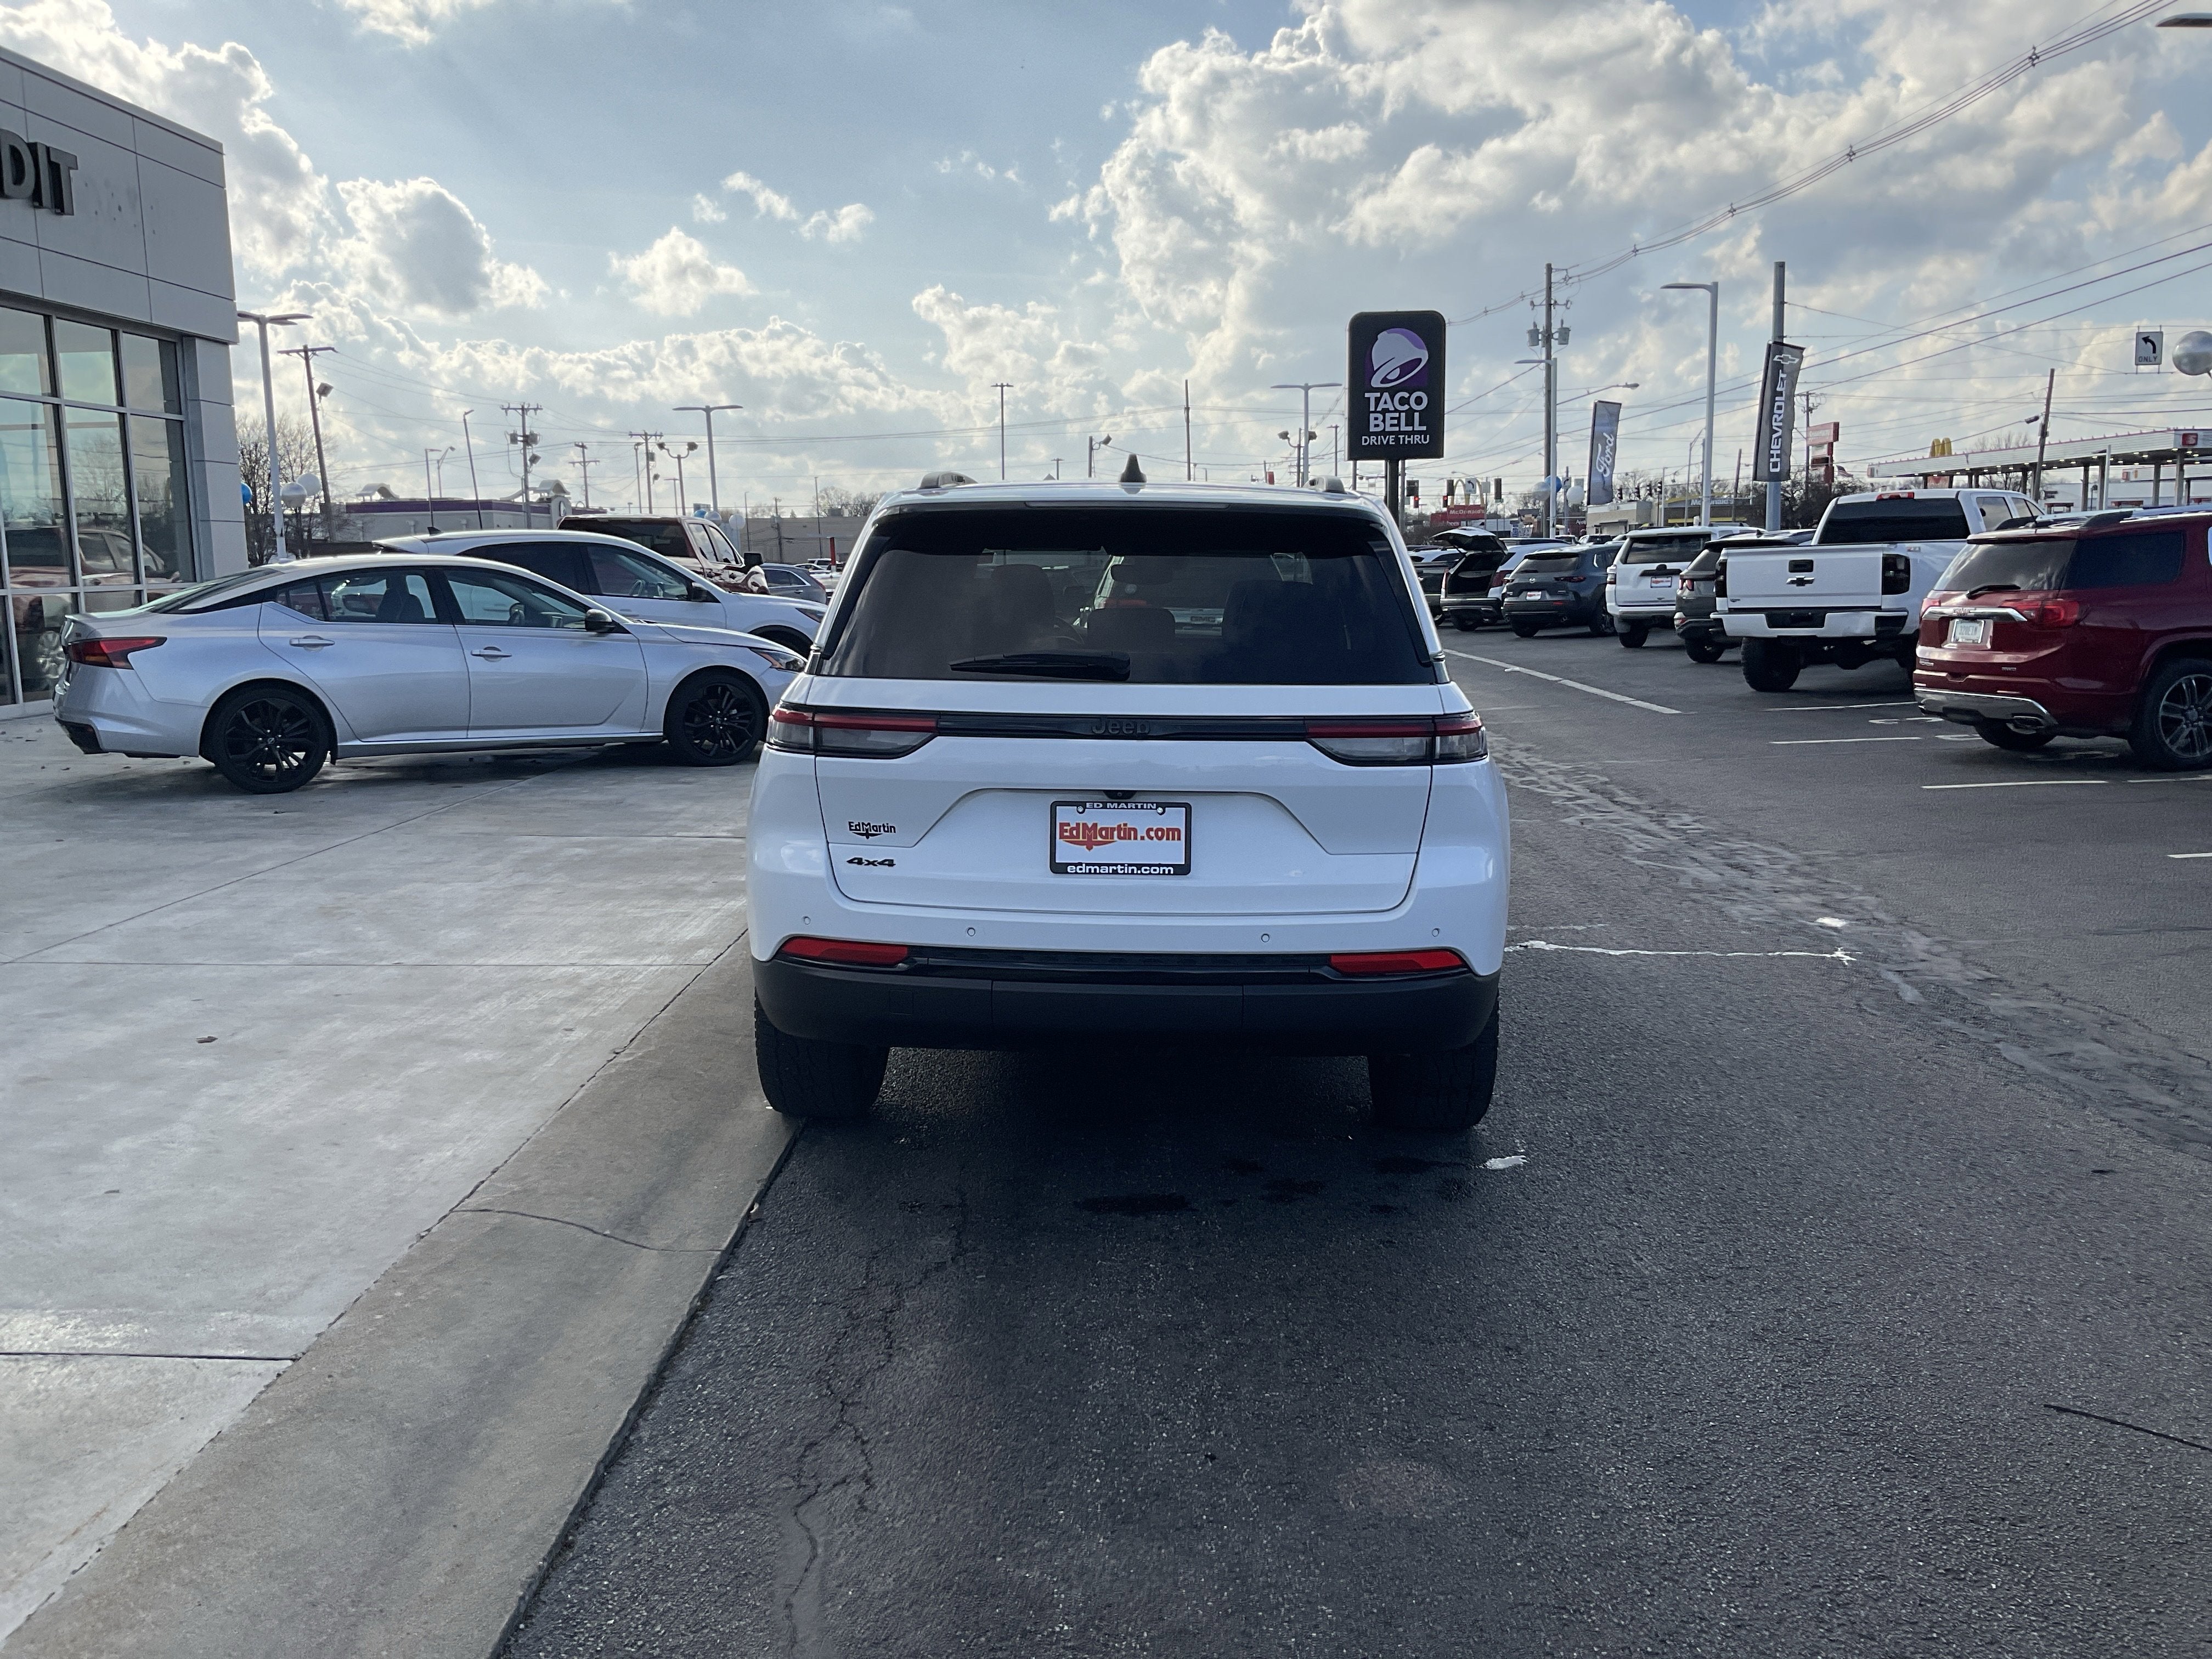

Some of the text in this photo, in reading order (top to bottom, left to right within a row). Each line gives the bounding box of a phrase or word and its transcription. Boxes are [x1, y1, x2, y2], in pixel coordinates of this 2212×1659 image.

[1364, 391, 1428, 411] TACO
[1369, 412, 1426, 432] BELL
[1769, 369, 1787, 473] CHEVROLET
[1362, 435, 1430, 445] DRIVE THRU
[1596, 432, 1615, 477] Ford
[1953, 607, 1976, 616] GMC
[1091, 716, 1151, 735] Jeep
[848, 821, 896, 834] EdMartin
[1059, 822, 1181, 842] EdMartin.com
[846, 857, 896, 867] 4x4
[1066, 863, 1174, 874] edmartin.com
